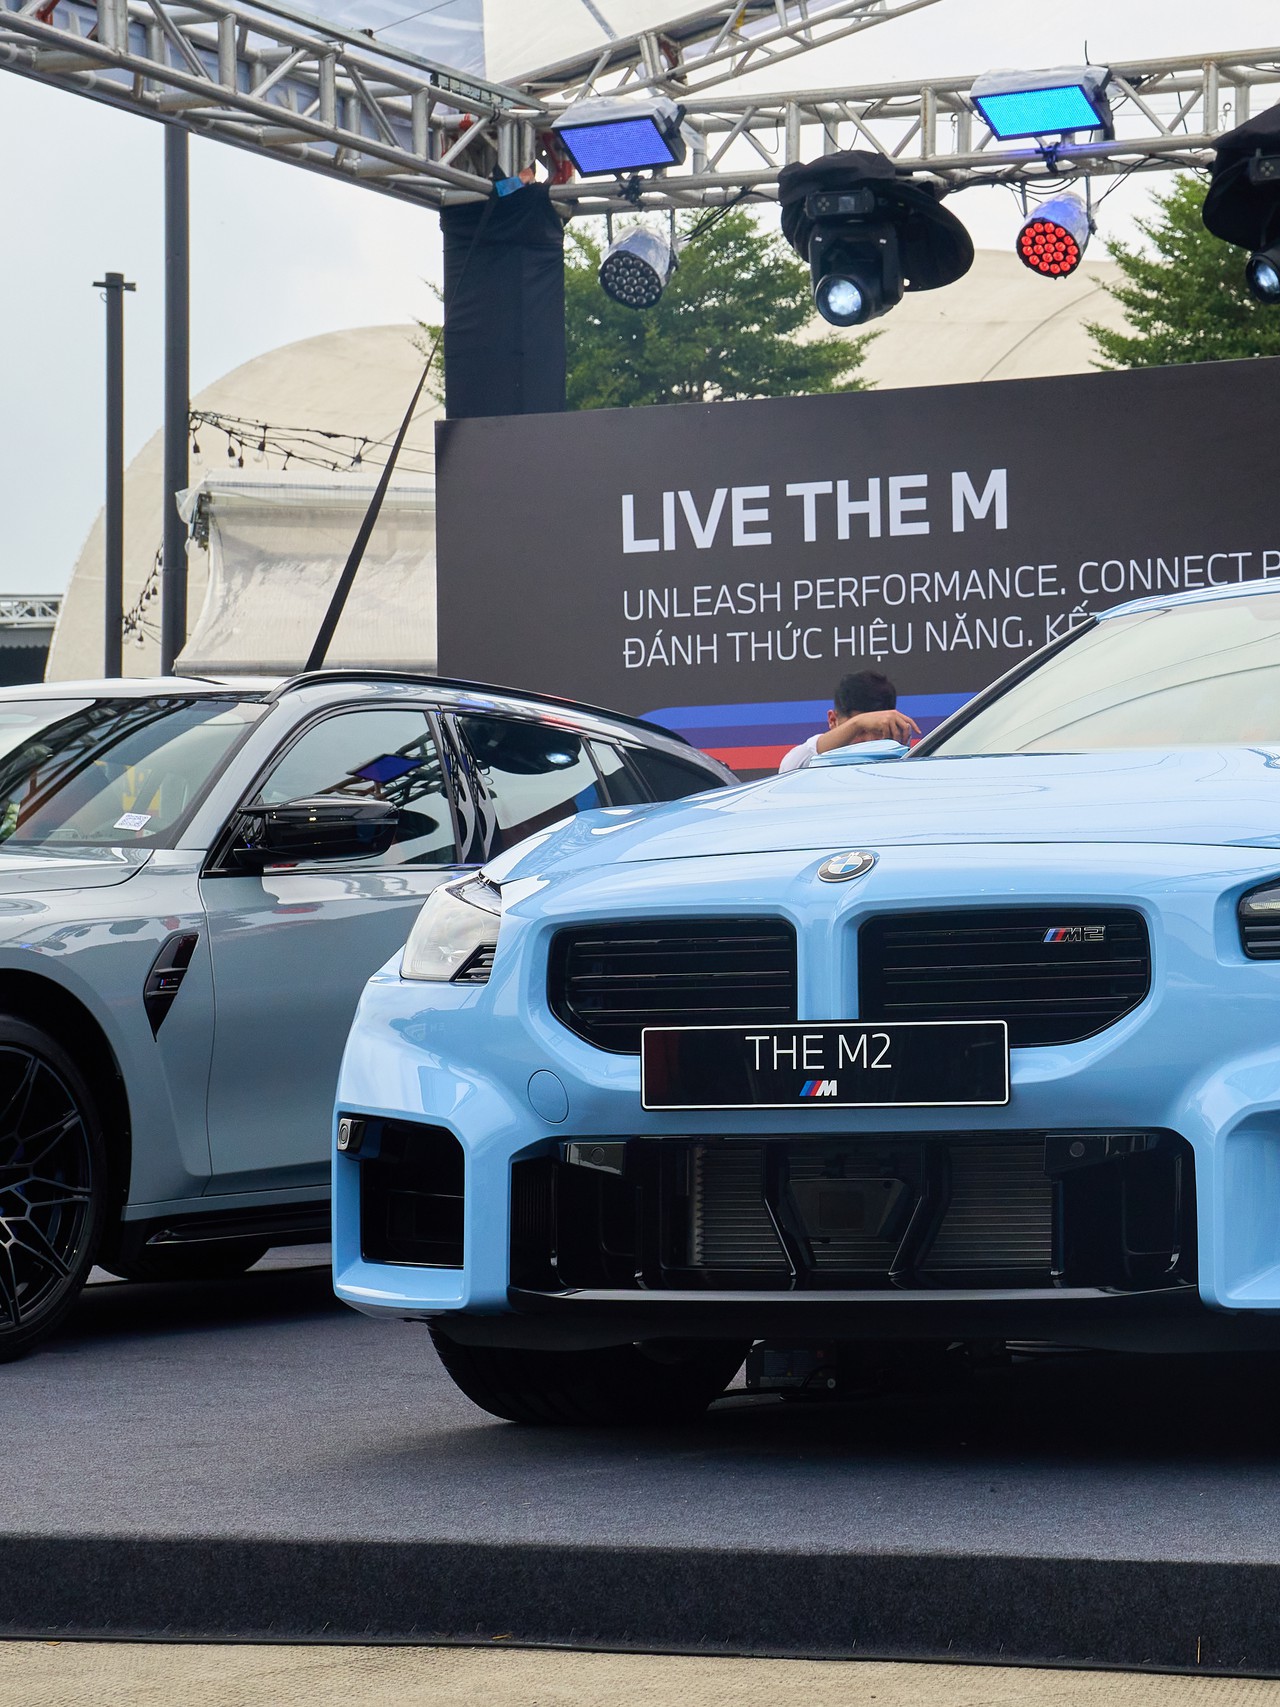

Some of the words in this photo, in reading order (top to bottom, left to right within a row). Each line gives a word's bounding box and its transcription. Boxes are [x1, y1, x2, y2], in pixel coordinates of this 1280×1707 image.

[621, 485, 772, 554] LIVE
[786, 474, 930, 543] THE
[951, 469, 1008, 533] M
[623, 582, 781, 621] UNLEASH
[794, 564, 1067, 611] PERFORMANCE.
[1078, 551, 1253, 594] CONNECT
[622, 628, 718, 669] ĐÁNH
[727, 621, 823, 663] THỨC
[834, 617, 912, 662] HIỆU
[926, 612, 1034, 653] NĂNG.
[1045, 600, 1101, 646] KẾ
[1062, 925, 1106, 943] M2
[745, 1035, 825, 1071] THE
[838, 1032, 892, 1069] M2
[813, 1079, 838, 1097] M
